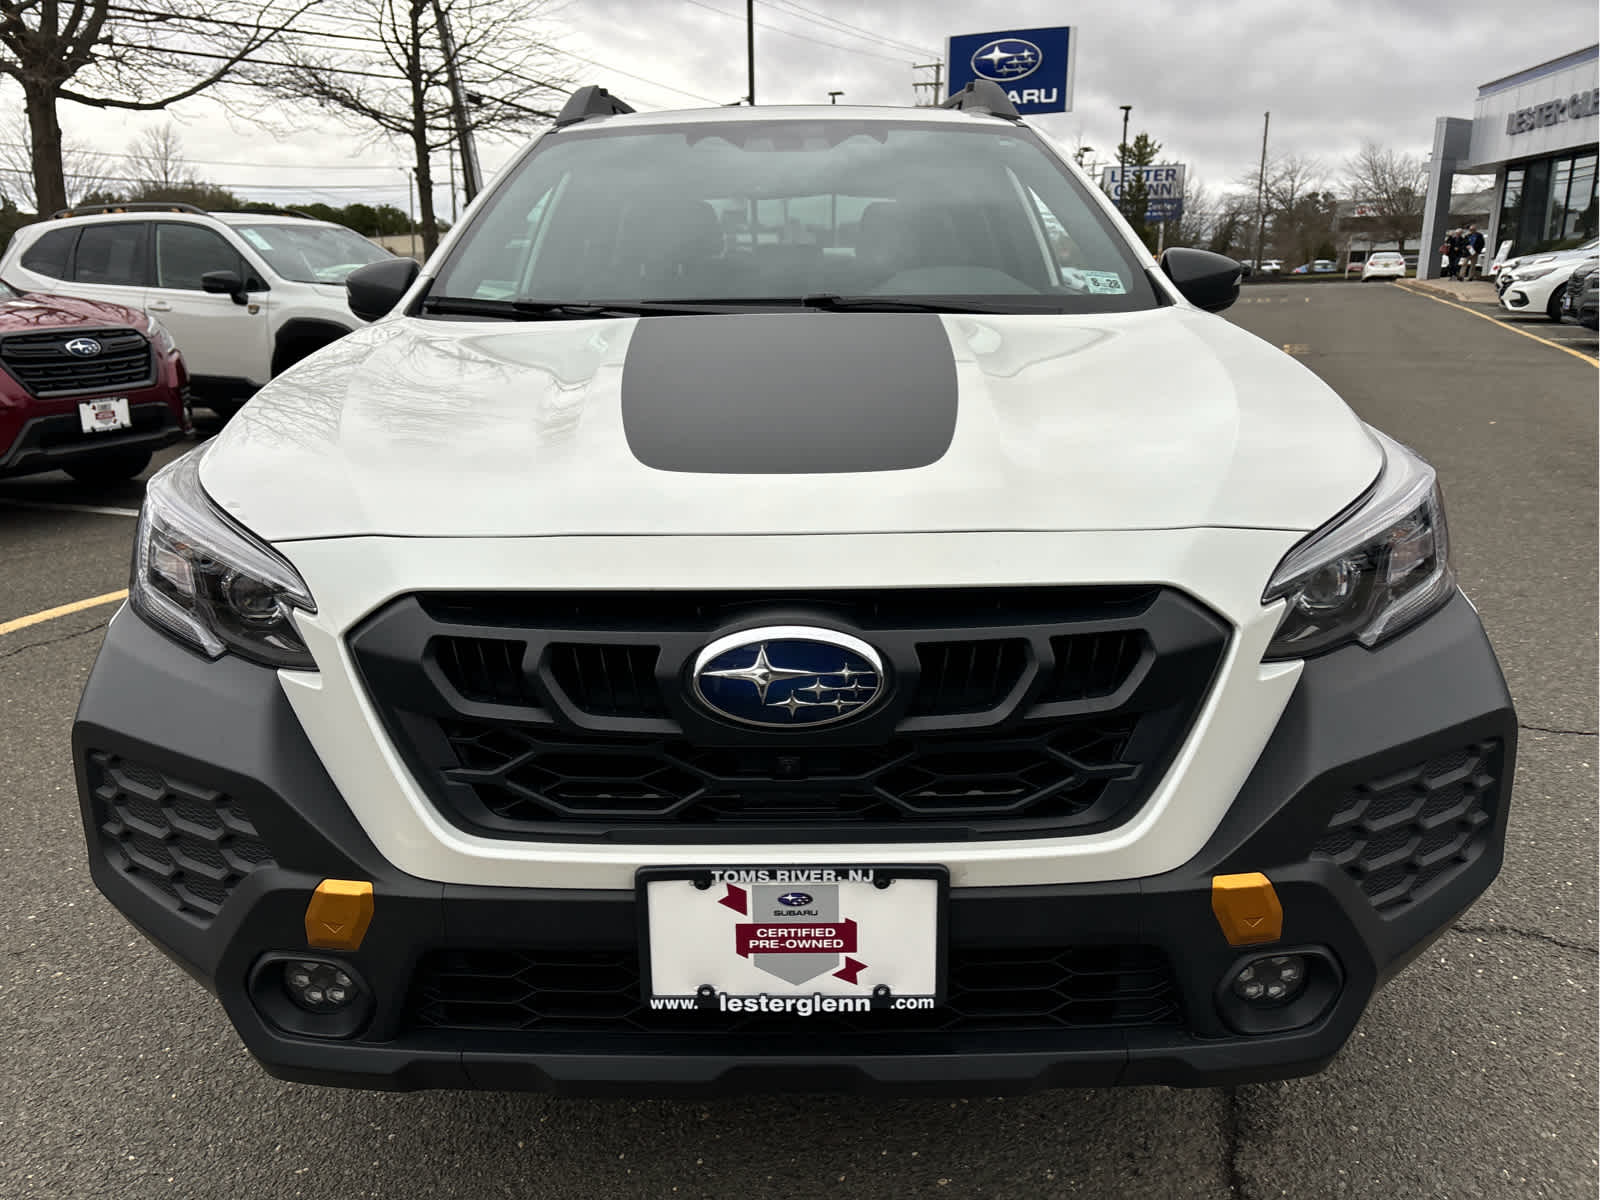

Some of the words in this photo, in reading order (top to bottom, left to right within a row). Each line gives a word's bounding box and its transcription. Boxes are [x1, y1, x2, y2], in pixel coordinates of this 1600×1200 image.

[1008, 88, 1058, 104] ARU
[1506, 99, 1567, 135] LESTER
[1111, 168, 1177, 182] LESTER
[1114, 183, 1172, 197] GNN
[711, 870, 769, 883] TOMS
[848, 869, 874, 882] NJ
[756, 928, 836, 938] CERTIFIED
[749, 939, 844, 949] PRE-OWNED
[650, 999, 699, 1010] www.
[720, 994, 871, 1017] lesterglenn
[890, 998, 935, 1010] .com
